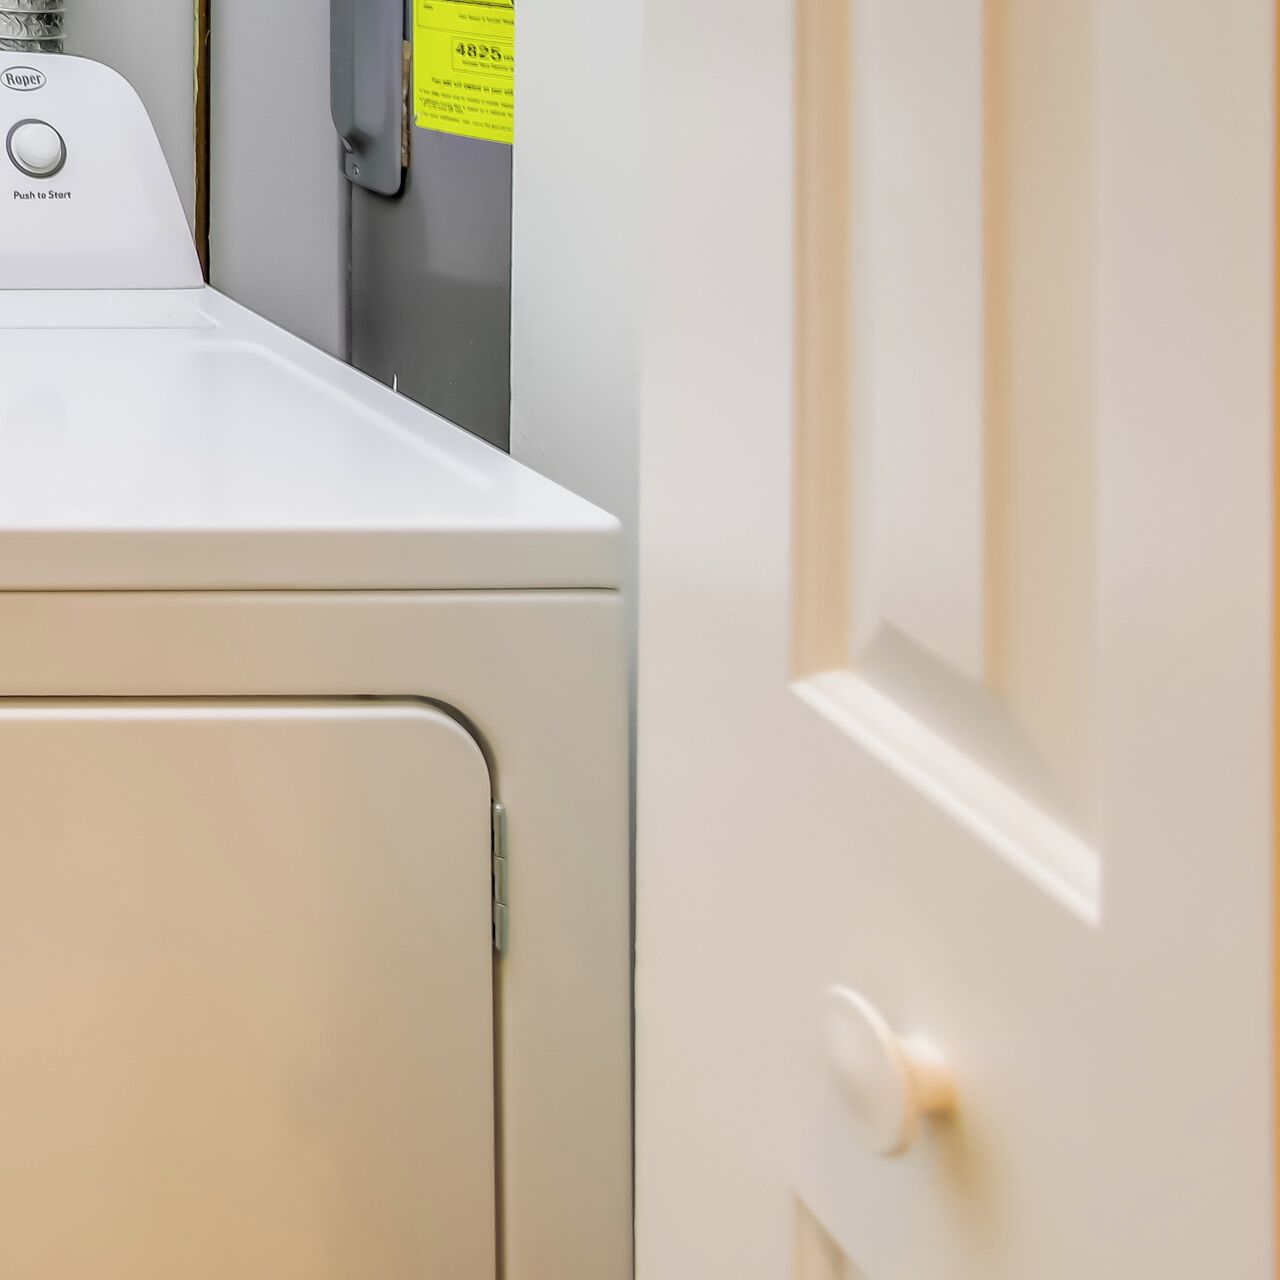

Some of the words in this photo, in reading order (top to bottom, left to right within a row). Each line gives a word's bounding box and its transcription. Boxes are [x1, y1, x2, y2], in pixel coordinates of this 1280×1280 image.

[455, 42, 503, 61] 4825
[5, 72, 42, 88] Roper
[13, 190, 36, 200] Push
[37, 191, 47, 200] to
[48, 190, 72, 200] Start
